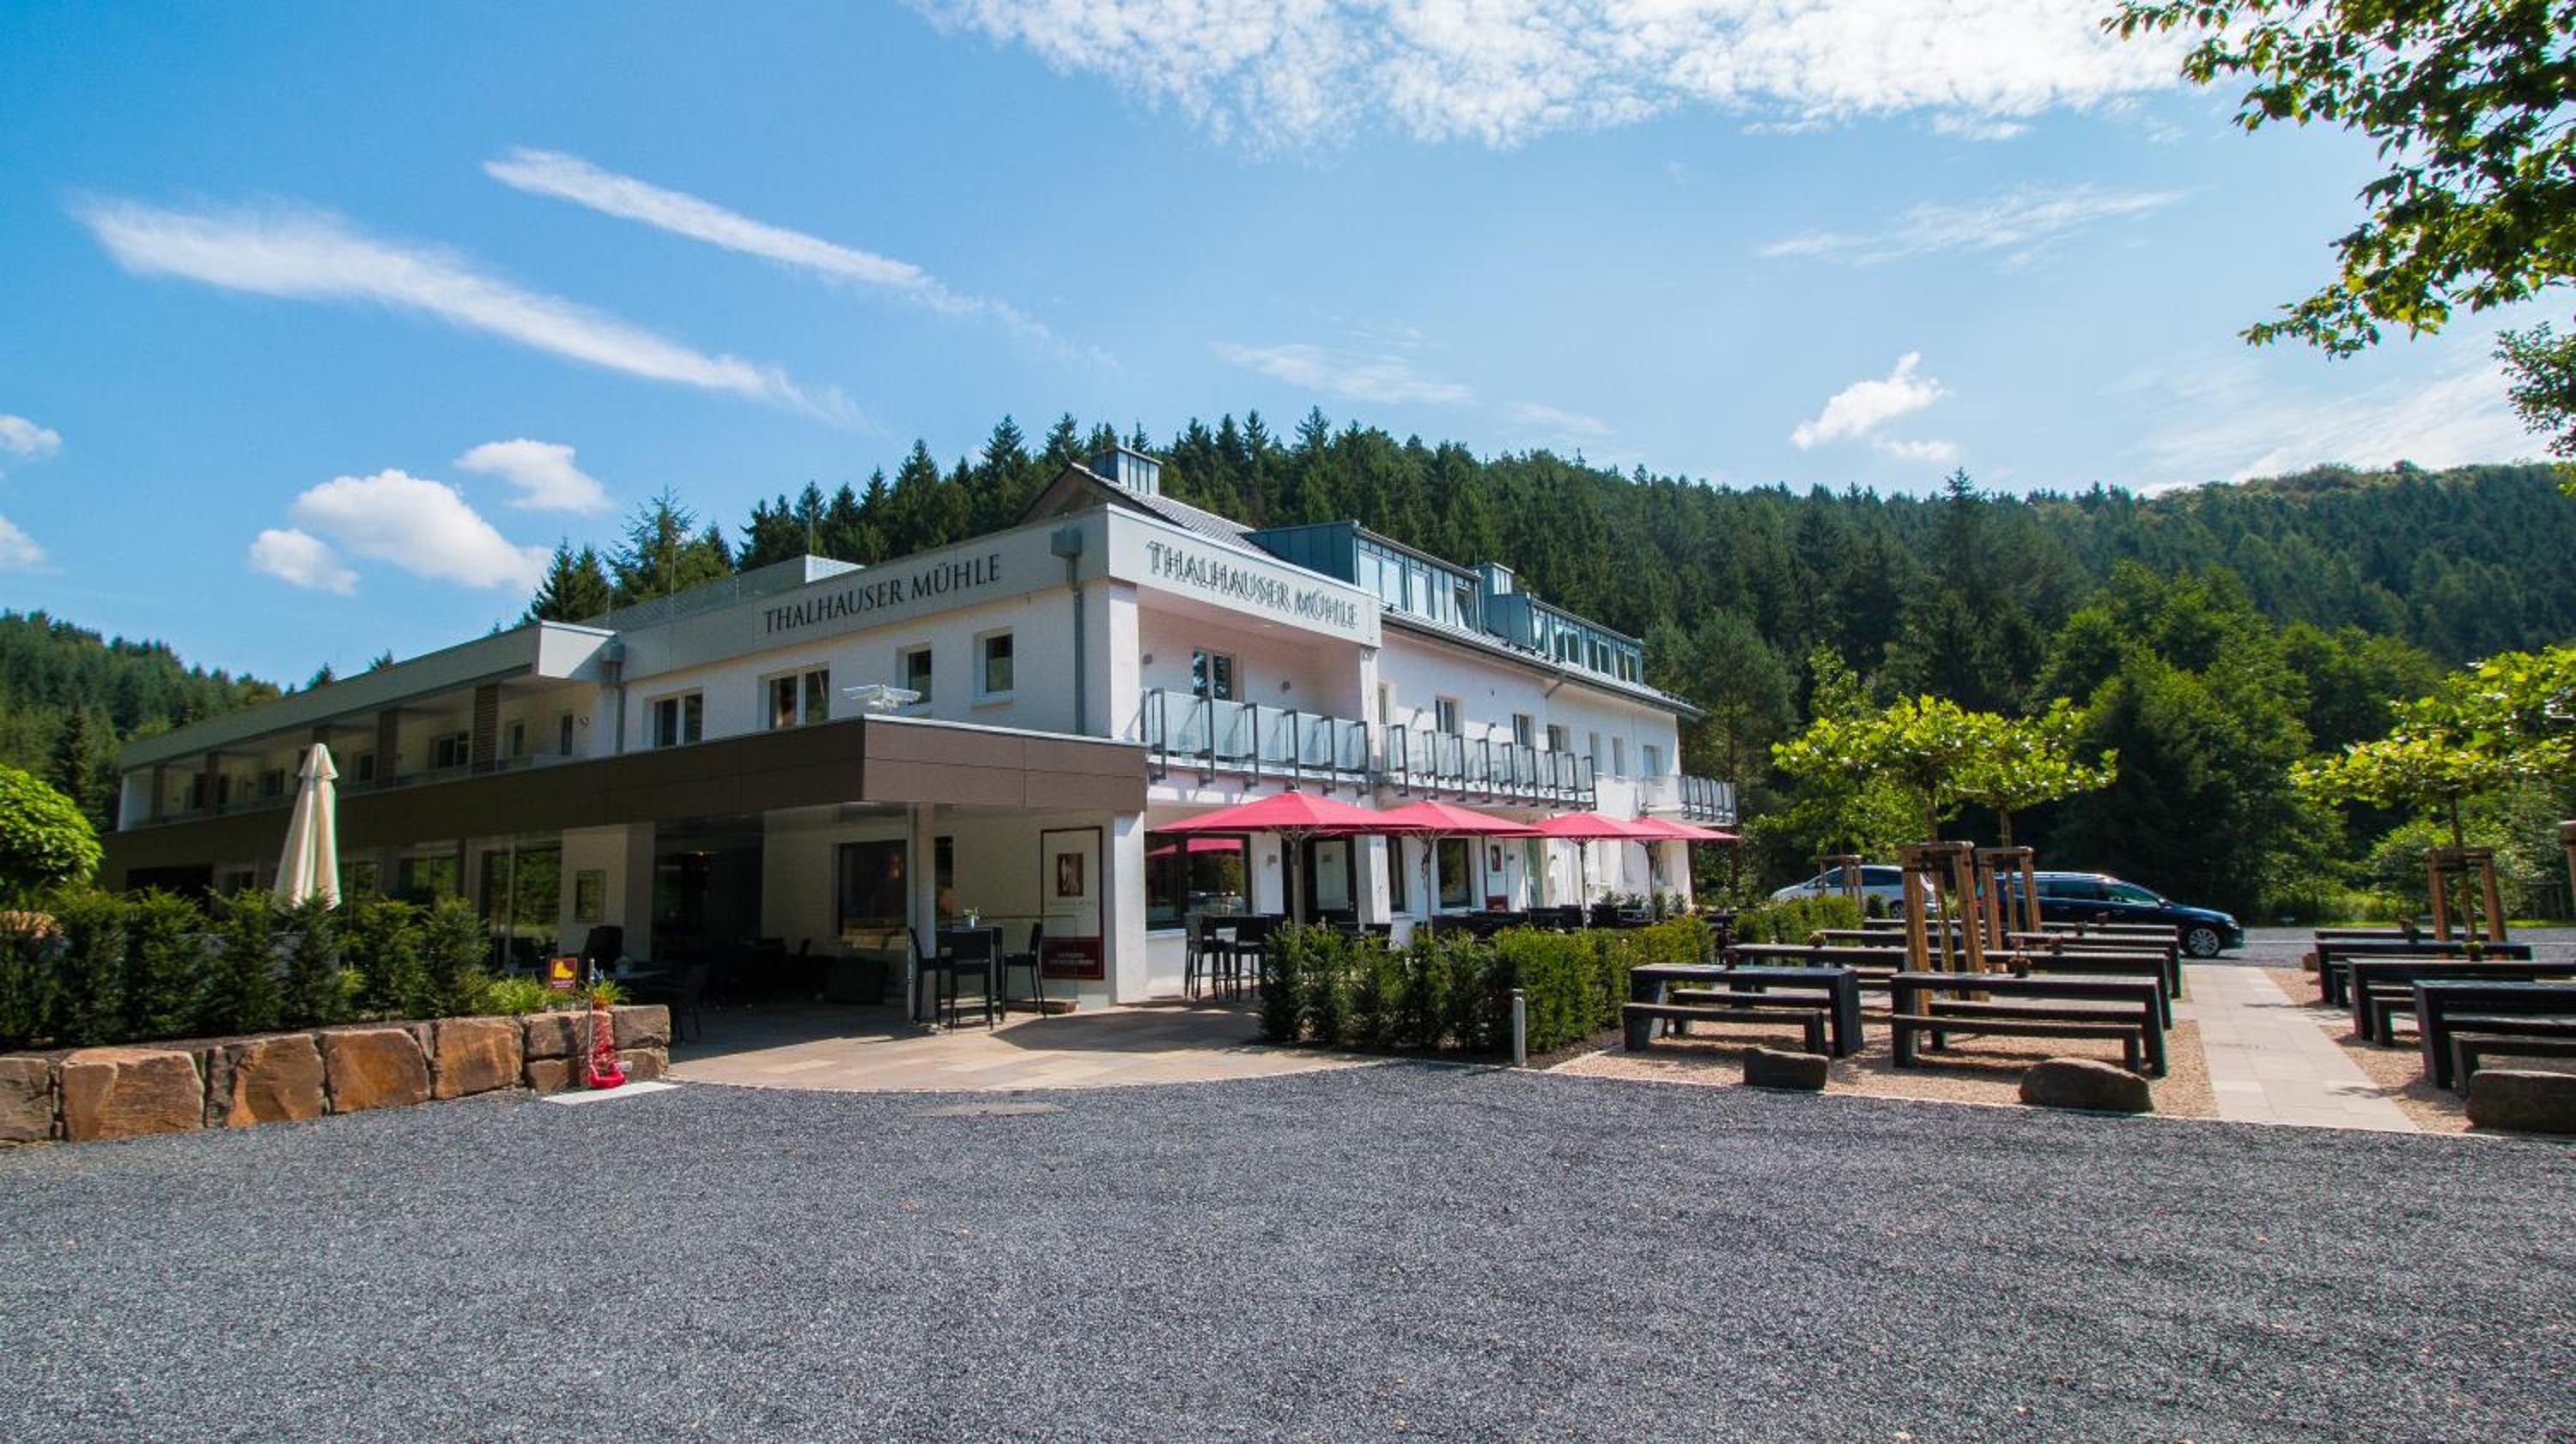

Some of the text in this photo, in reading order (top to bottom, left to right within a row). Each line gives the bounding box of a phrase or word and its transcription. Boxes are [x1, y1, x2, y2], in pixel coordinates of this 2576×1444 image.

[765, 553, 1001, 634] THALHAUSER MÜHLE
[1146, 540, 1358, 629] THALHAUSER MÜHLE
